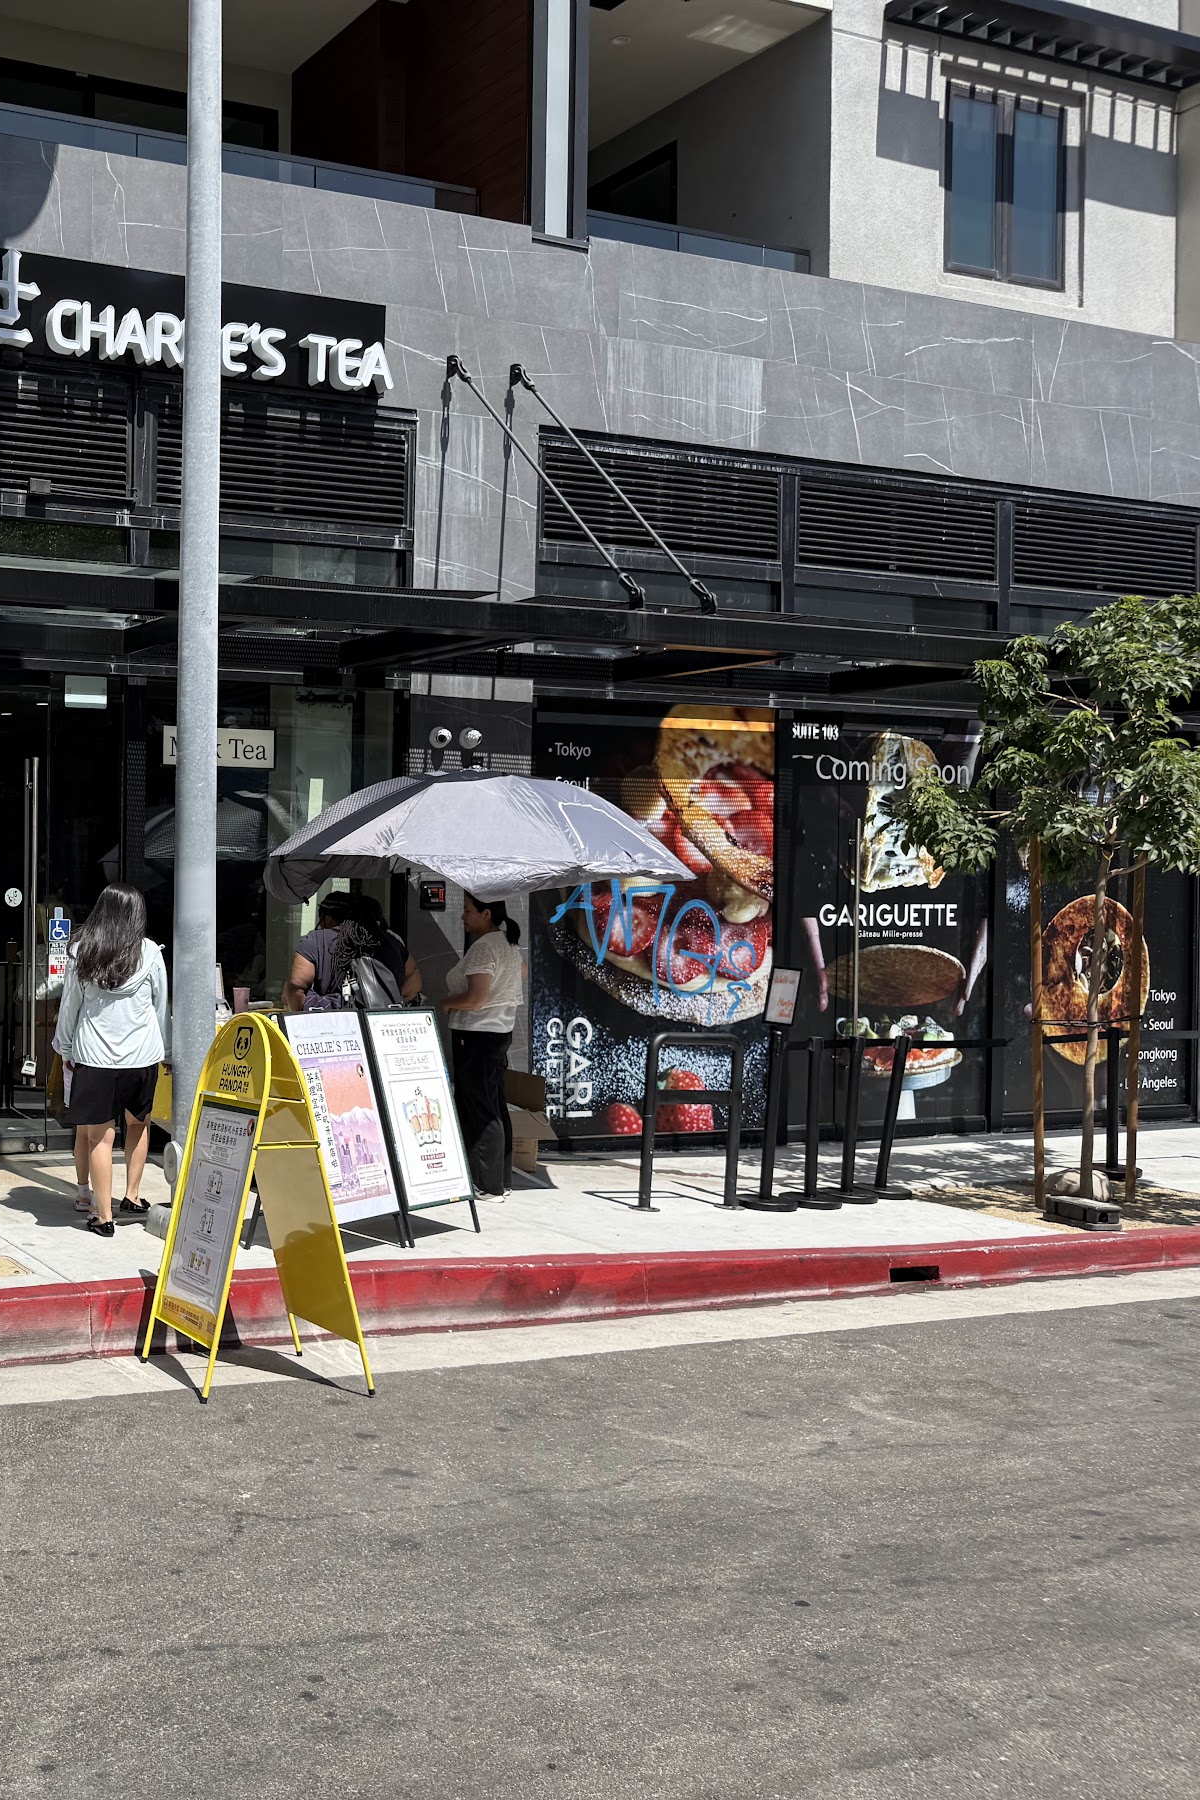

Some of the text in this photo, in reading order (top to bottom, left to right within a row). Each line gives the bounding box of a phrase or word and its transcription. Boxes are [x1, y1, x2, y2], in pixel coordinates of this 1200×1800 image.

[45, 299, 394, 394] CHARE'S TEA
[792, 722, 839, 741] SUITE 103
[228, 738, 268, 761] Tea
[554, 742, 592, 760] Tokyo
[815, 754, 907, 790] Coming
[819, 903, 958, 927] GARIGUETTE
[882, 929, 924, 939] Mille-pressé
[1149, 988, 1177, 1004] Tokyo
[1148, 1017, 1174, 1031] Seoul
[296, 1040, 361, 1056] CHARLIE'S TEA
[1137, 1047, 1178, 1063] ongkong
[221, 1063, 253, 1078] HUNGRY
[546, 1017, 564, 1119] GUETTE
[565, 1016, 593, 1118] GARI
[219, 1078, 243, 1093] PANDA
[1141, 1076, 1178, 1091] Angeles
